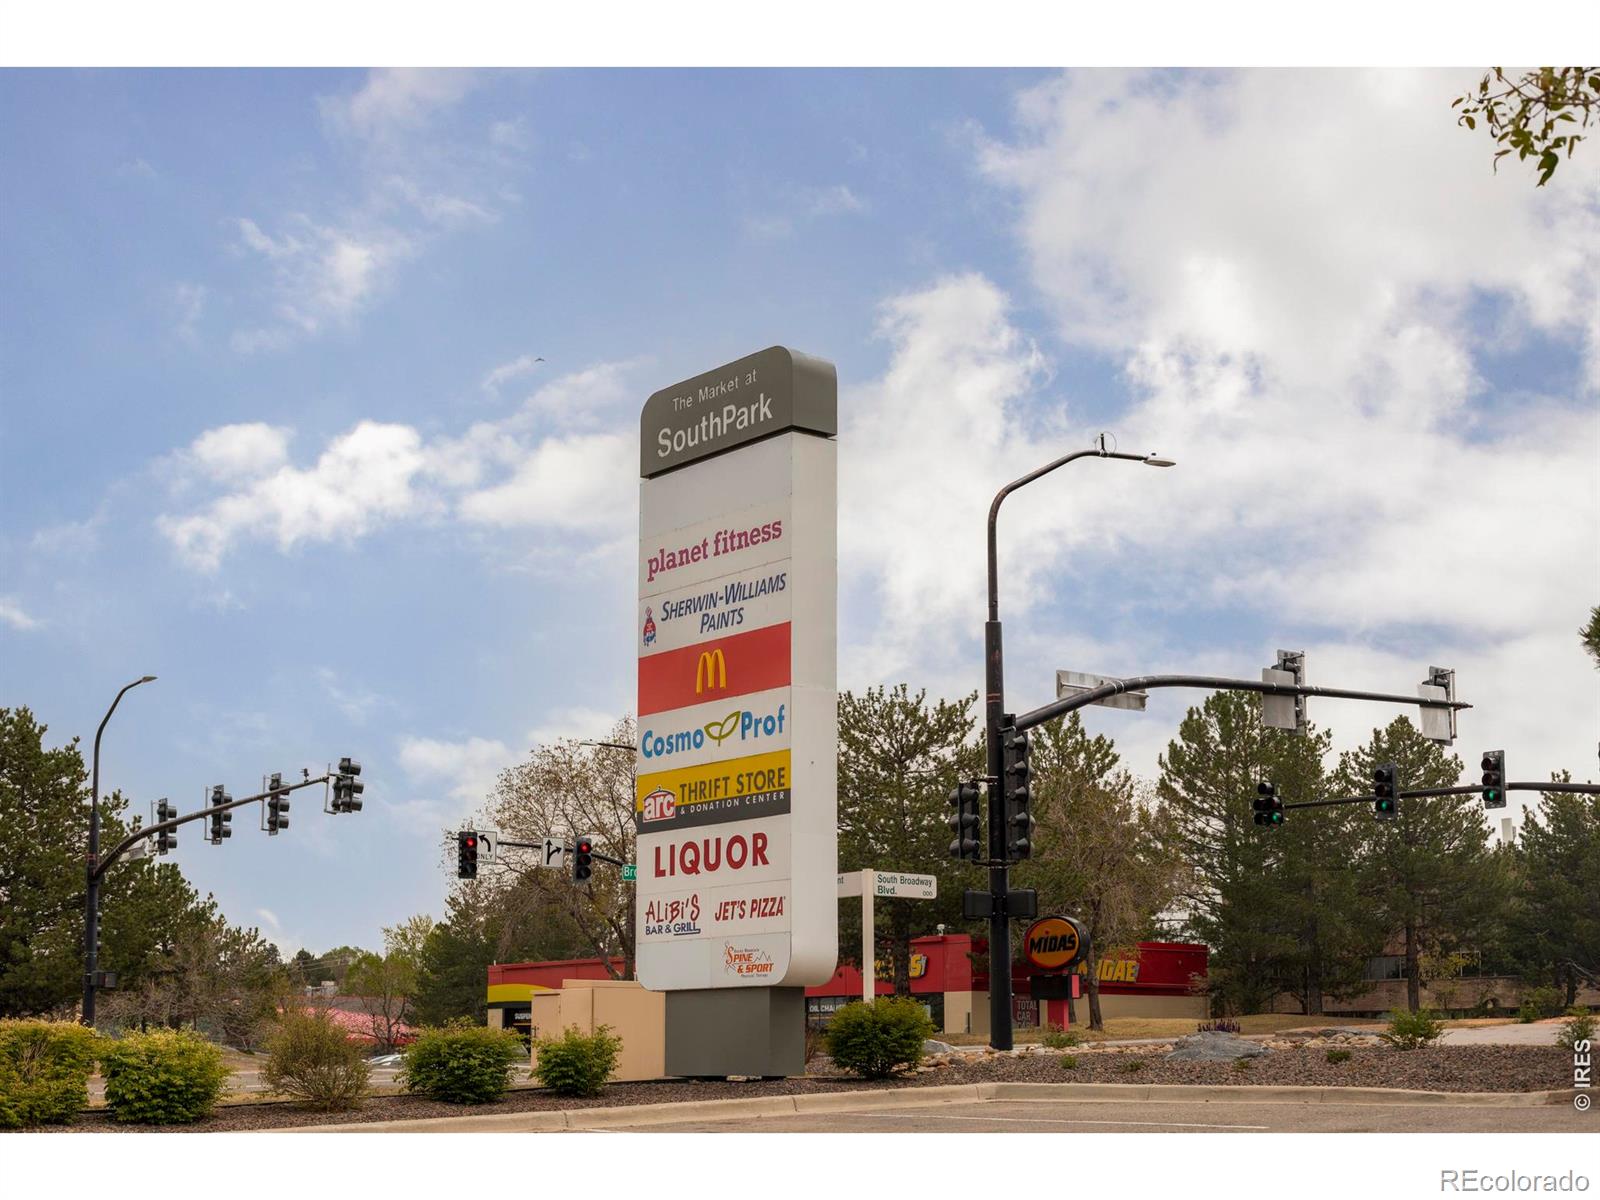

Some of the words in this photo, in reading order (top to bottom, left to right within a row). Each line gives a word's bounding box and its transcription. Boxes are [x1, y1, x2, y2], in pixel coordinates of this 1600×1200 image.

[672, 395, 693, 412] The
[698, 376, 739, 403] Market
[744, 369, 757, 385] at
[657, 393, 773, 457] SouthPark
[647, 536, 709, 582] planet
[713, 520, 783, 557] fitness
[661, 573, 787, 622] SHERWIN-WILLIAMS
[700, 607, 744, 634] PAINTS
[641, 728, 704, 759] Cosmo
[741, 704, 785, 740] Prof
[679, 776, 730, 803] THRIFT
[736, 767, 786, 794] STORE
[643, 793, 676, 819] arc
[691, 800, 740, 813] DONATION
[745, 791, 785, 805] CENTER
[654, 832, 770, 878] LIQUOR
[877, 874, 898, 884] South
[900, 876, 932, 888] Broadway
[878, 886, 897, 895] Blvd.
[715, 900, 747, 921] JET'S
[750, 896, 784, 918] PIZZA
[645, 925, 663, 935] BAR
[665, 924, 672, 934] &
[674, 922, 699, 934] GRILL
[726, 946, 753, 965] SPINE
[737, 965, 743, 974] &
[745, 963, 774, 973] SPORT
[1016, 1000, 1038, 1010] TOTAL
[1017, 1010, 1031, 1020] CAR
